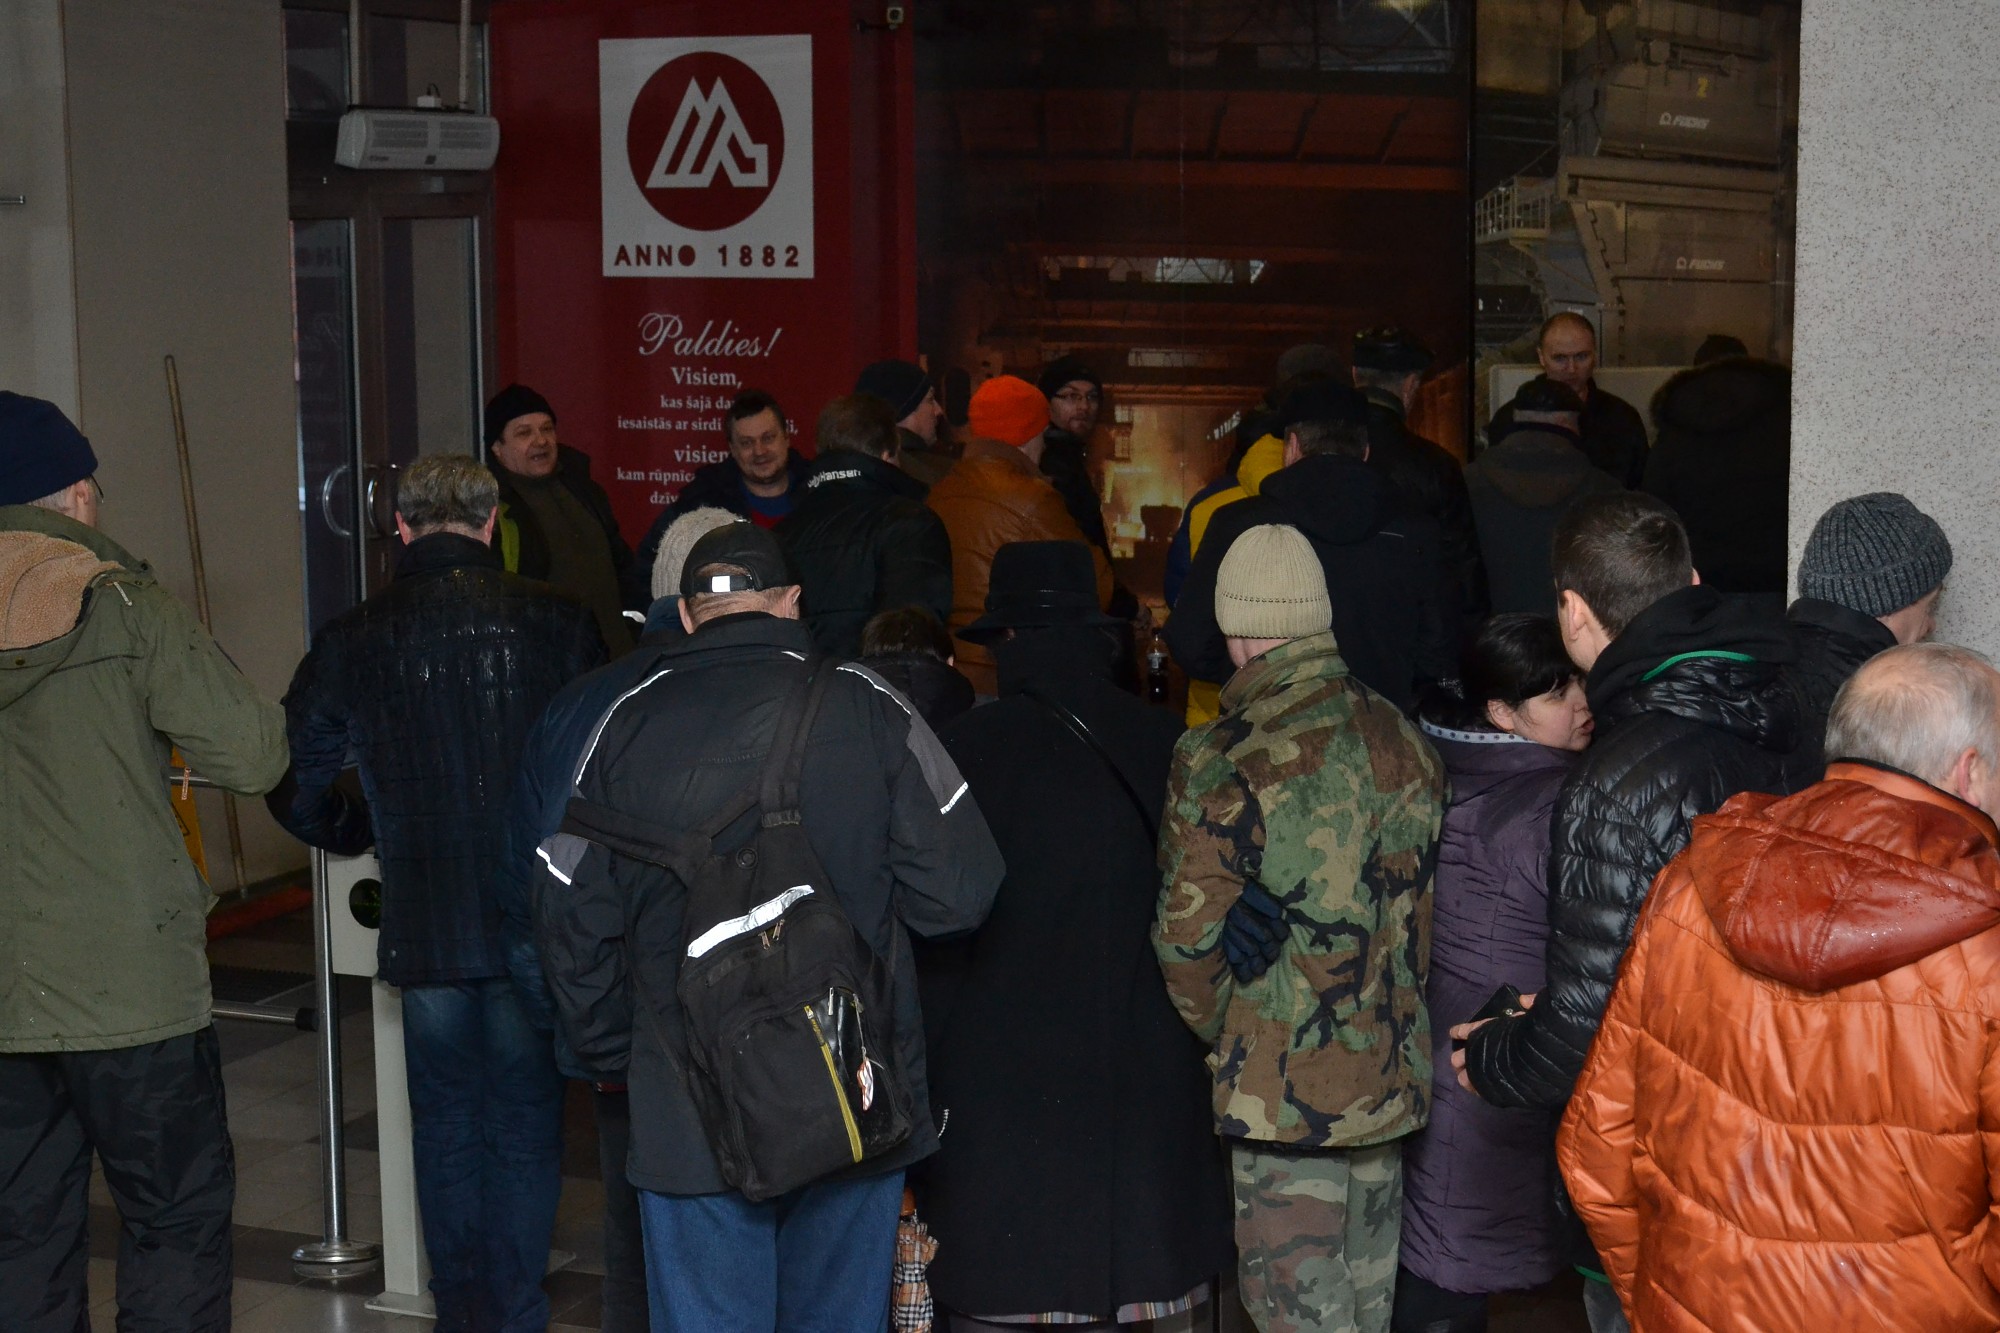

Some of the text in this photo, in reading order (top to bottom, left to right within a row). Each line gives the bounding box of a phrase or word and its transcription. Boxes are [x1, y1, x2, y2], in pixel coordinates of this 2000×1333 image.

[614, 244, 800, 268] ANNO 1882
[638, 312, 783, 357] Paldies!
[670, 366, 743, 389] Visiem,
[660, 395, 683, 410] kas
[686, 395, 712, 413] šajā
[617, 416, 722, 431] iesaistās ar sirdi
[616, 466, 697, 486] kam rūpnīc
[649, 490, 680, 505] dzīv
